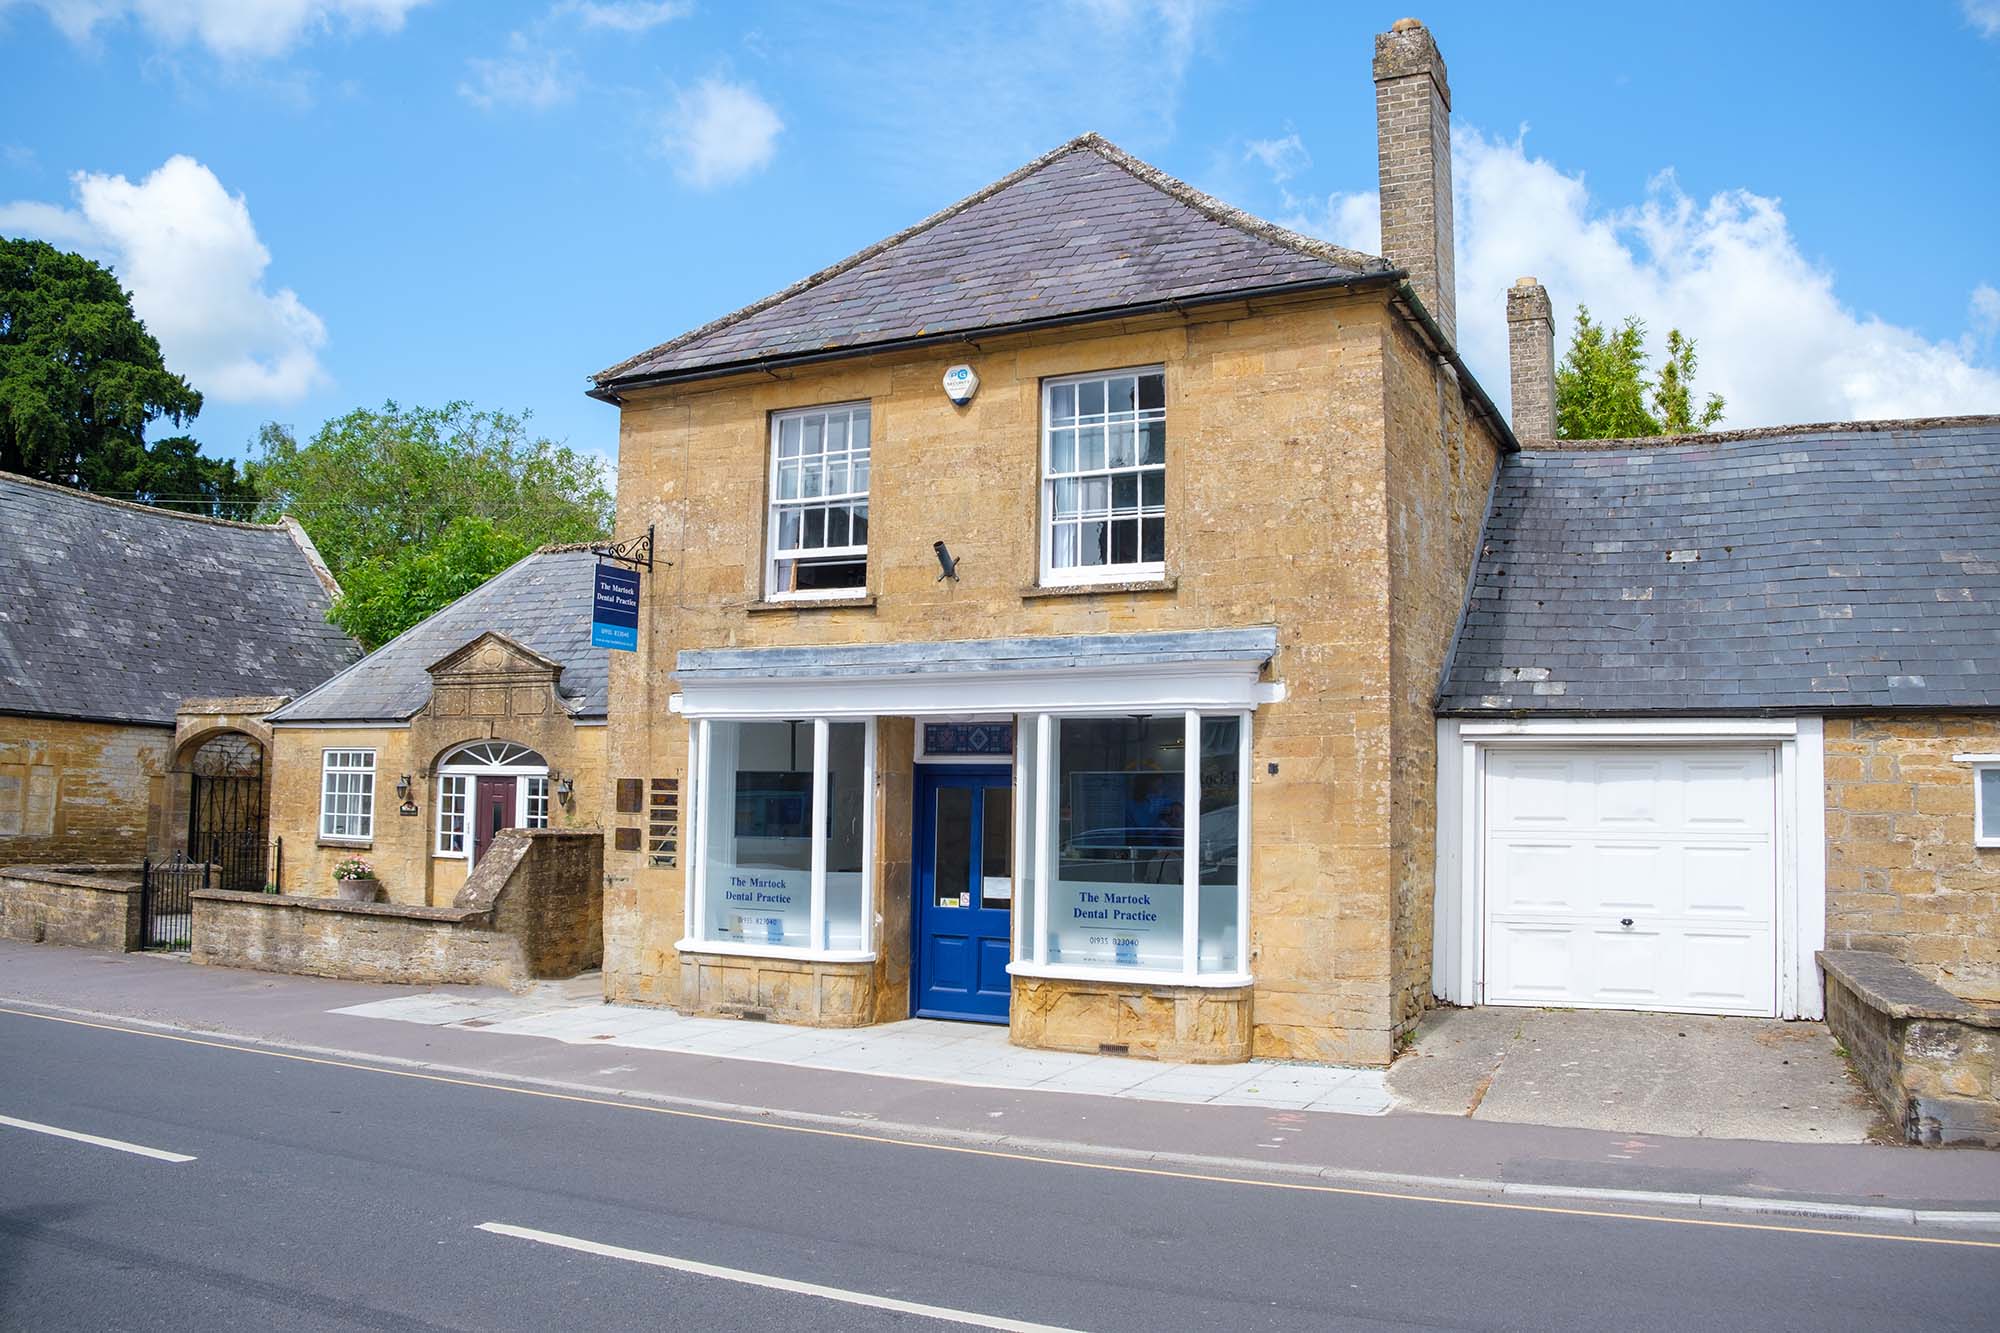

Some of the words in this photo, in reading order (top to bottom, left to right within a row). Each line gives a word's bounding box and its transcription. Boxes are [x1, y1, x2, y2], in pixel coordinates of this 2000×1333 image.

[601, 582, 611, 591] The
[612, 584, 634, 595] Martock
[597, 593, 614, 602] Dental
[616, 596, 637, 606] Practice
[730, 877, 746, 887] The
[750, 878, 786, 889] Martock
[726, 891, 753, 901] Dental
[757, 893, 791, 904] Practice
[1080, 892, 1099, 903] The
[1104, 893, 1151, 905] Martock
[1073, 908, 1108, 919] Dental
[1113, 909, 1157, 922] Practice
[1089, 936, 1109, 945] 01935
[1112, 937, 1139, 946] 823040
